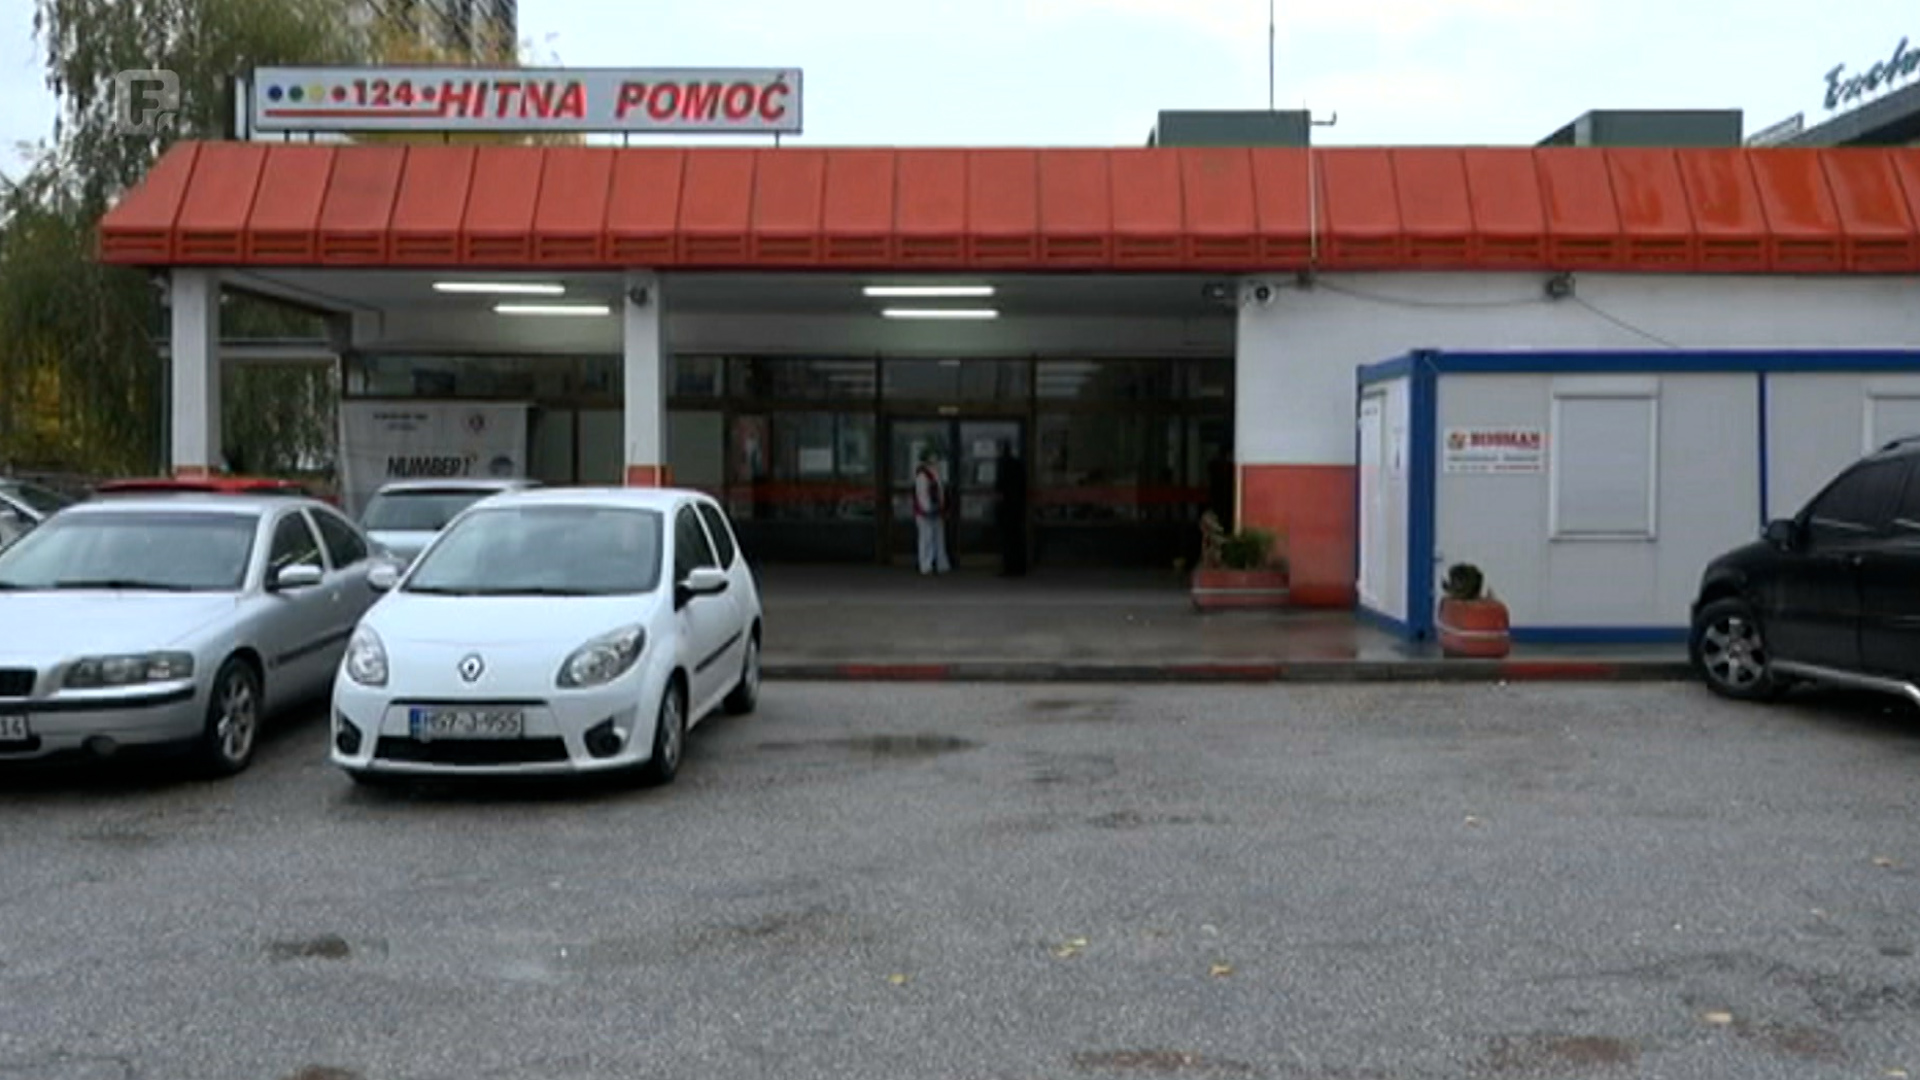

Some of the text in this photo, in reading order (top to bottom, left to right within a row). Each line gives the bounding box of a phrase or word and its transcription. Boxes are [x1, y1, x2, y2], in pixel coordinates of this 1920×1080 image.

[354, 71, 788, 120] 124 HITNA POMOĆ
